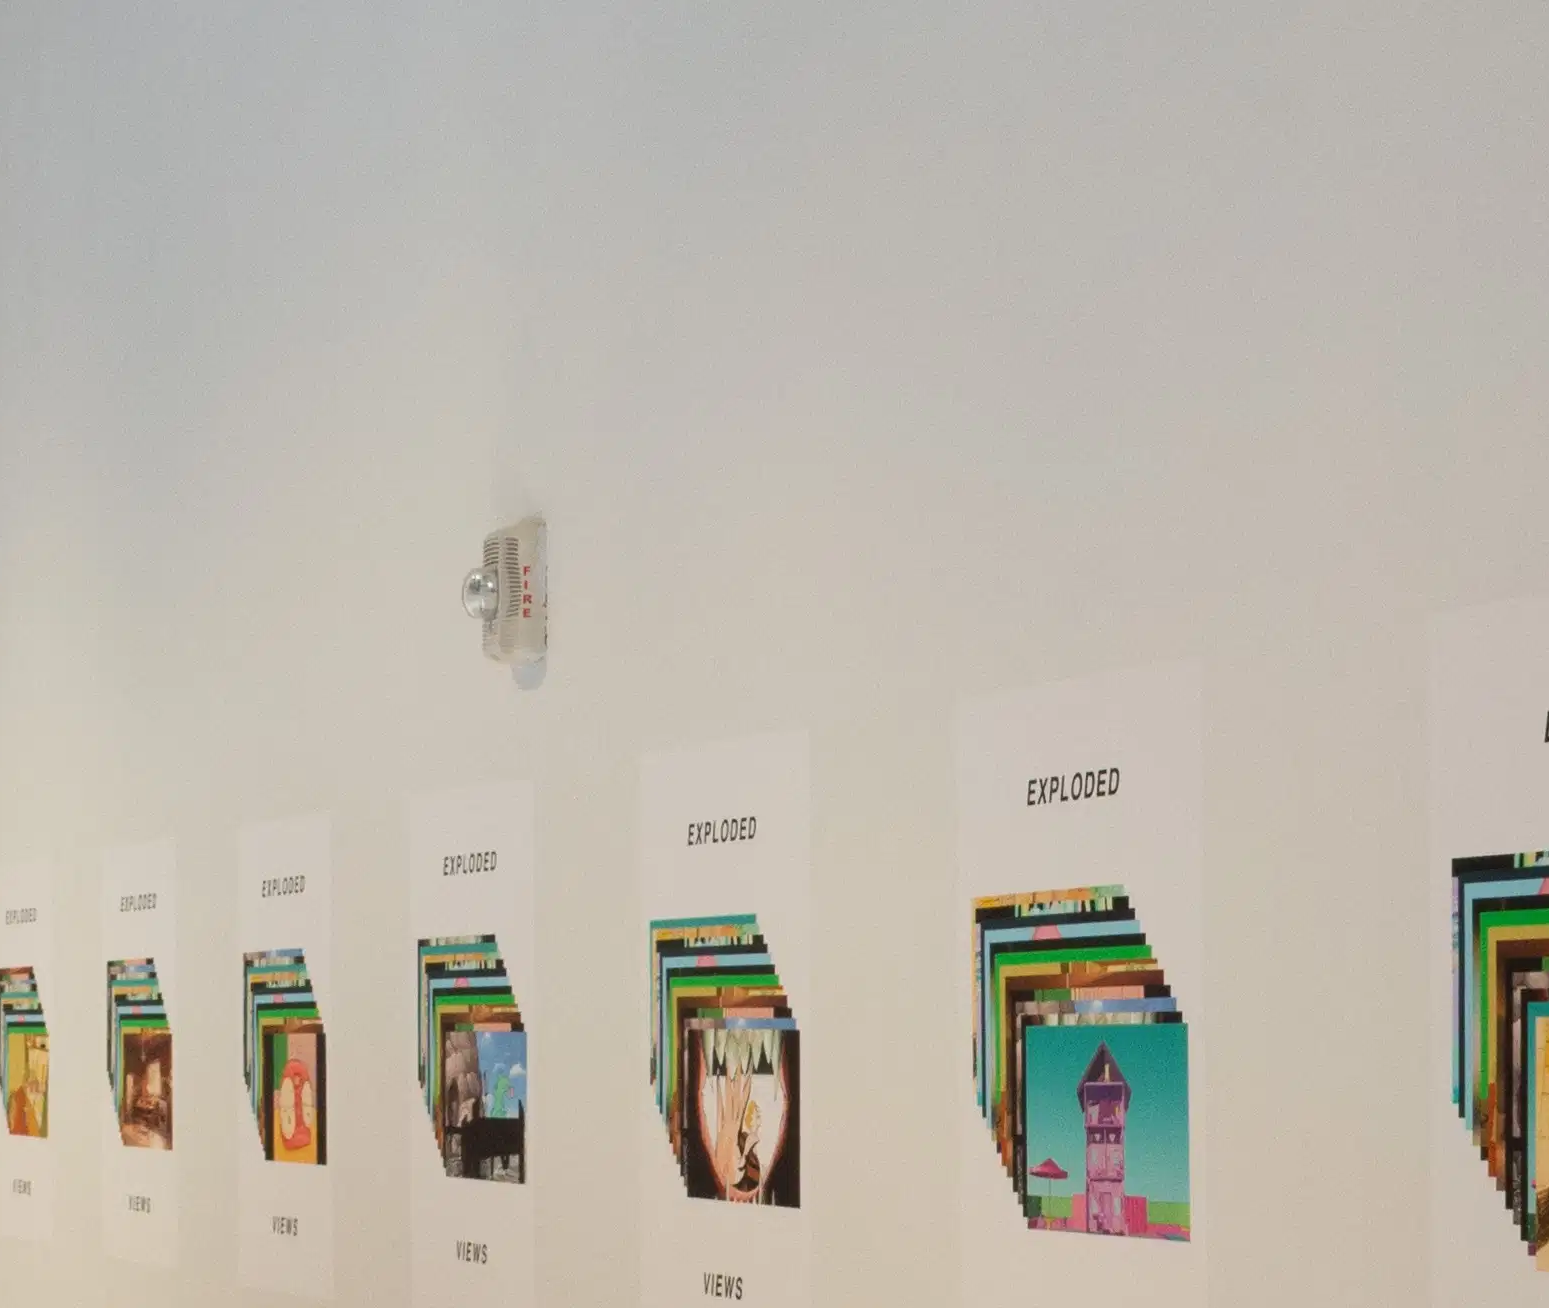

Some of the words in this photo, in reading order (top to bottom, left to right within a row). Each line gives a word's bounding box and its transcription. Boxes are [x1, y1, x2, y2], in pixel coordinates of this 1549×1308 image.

[522, 565, 533, 618] FIRE
[1026, 767, 1120, 806] EXPLODED
[687, 816, 757, 847] EXPLODED
[443, 850, 497, 877] EXPLODED
[261, 875, 306, 898] EXPLODED
[119, 892, 157, 913] EXPLODED
[272, 1216, 299, 1237] VIEWS
[456, 1241, 488, 1265] VIEWS
[703, 1273, 743, 1301] VIEWS
